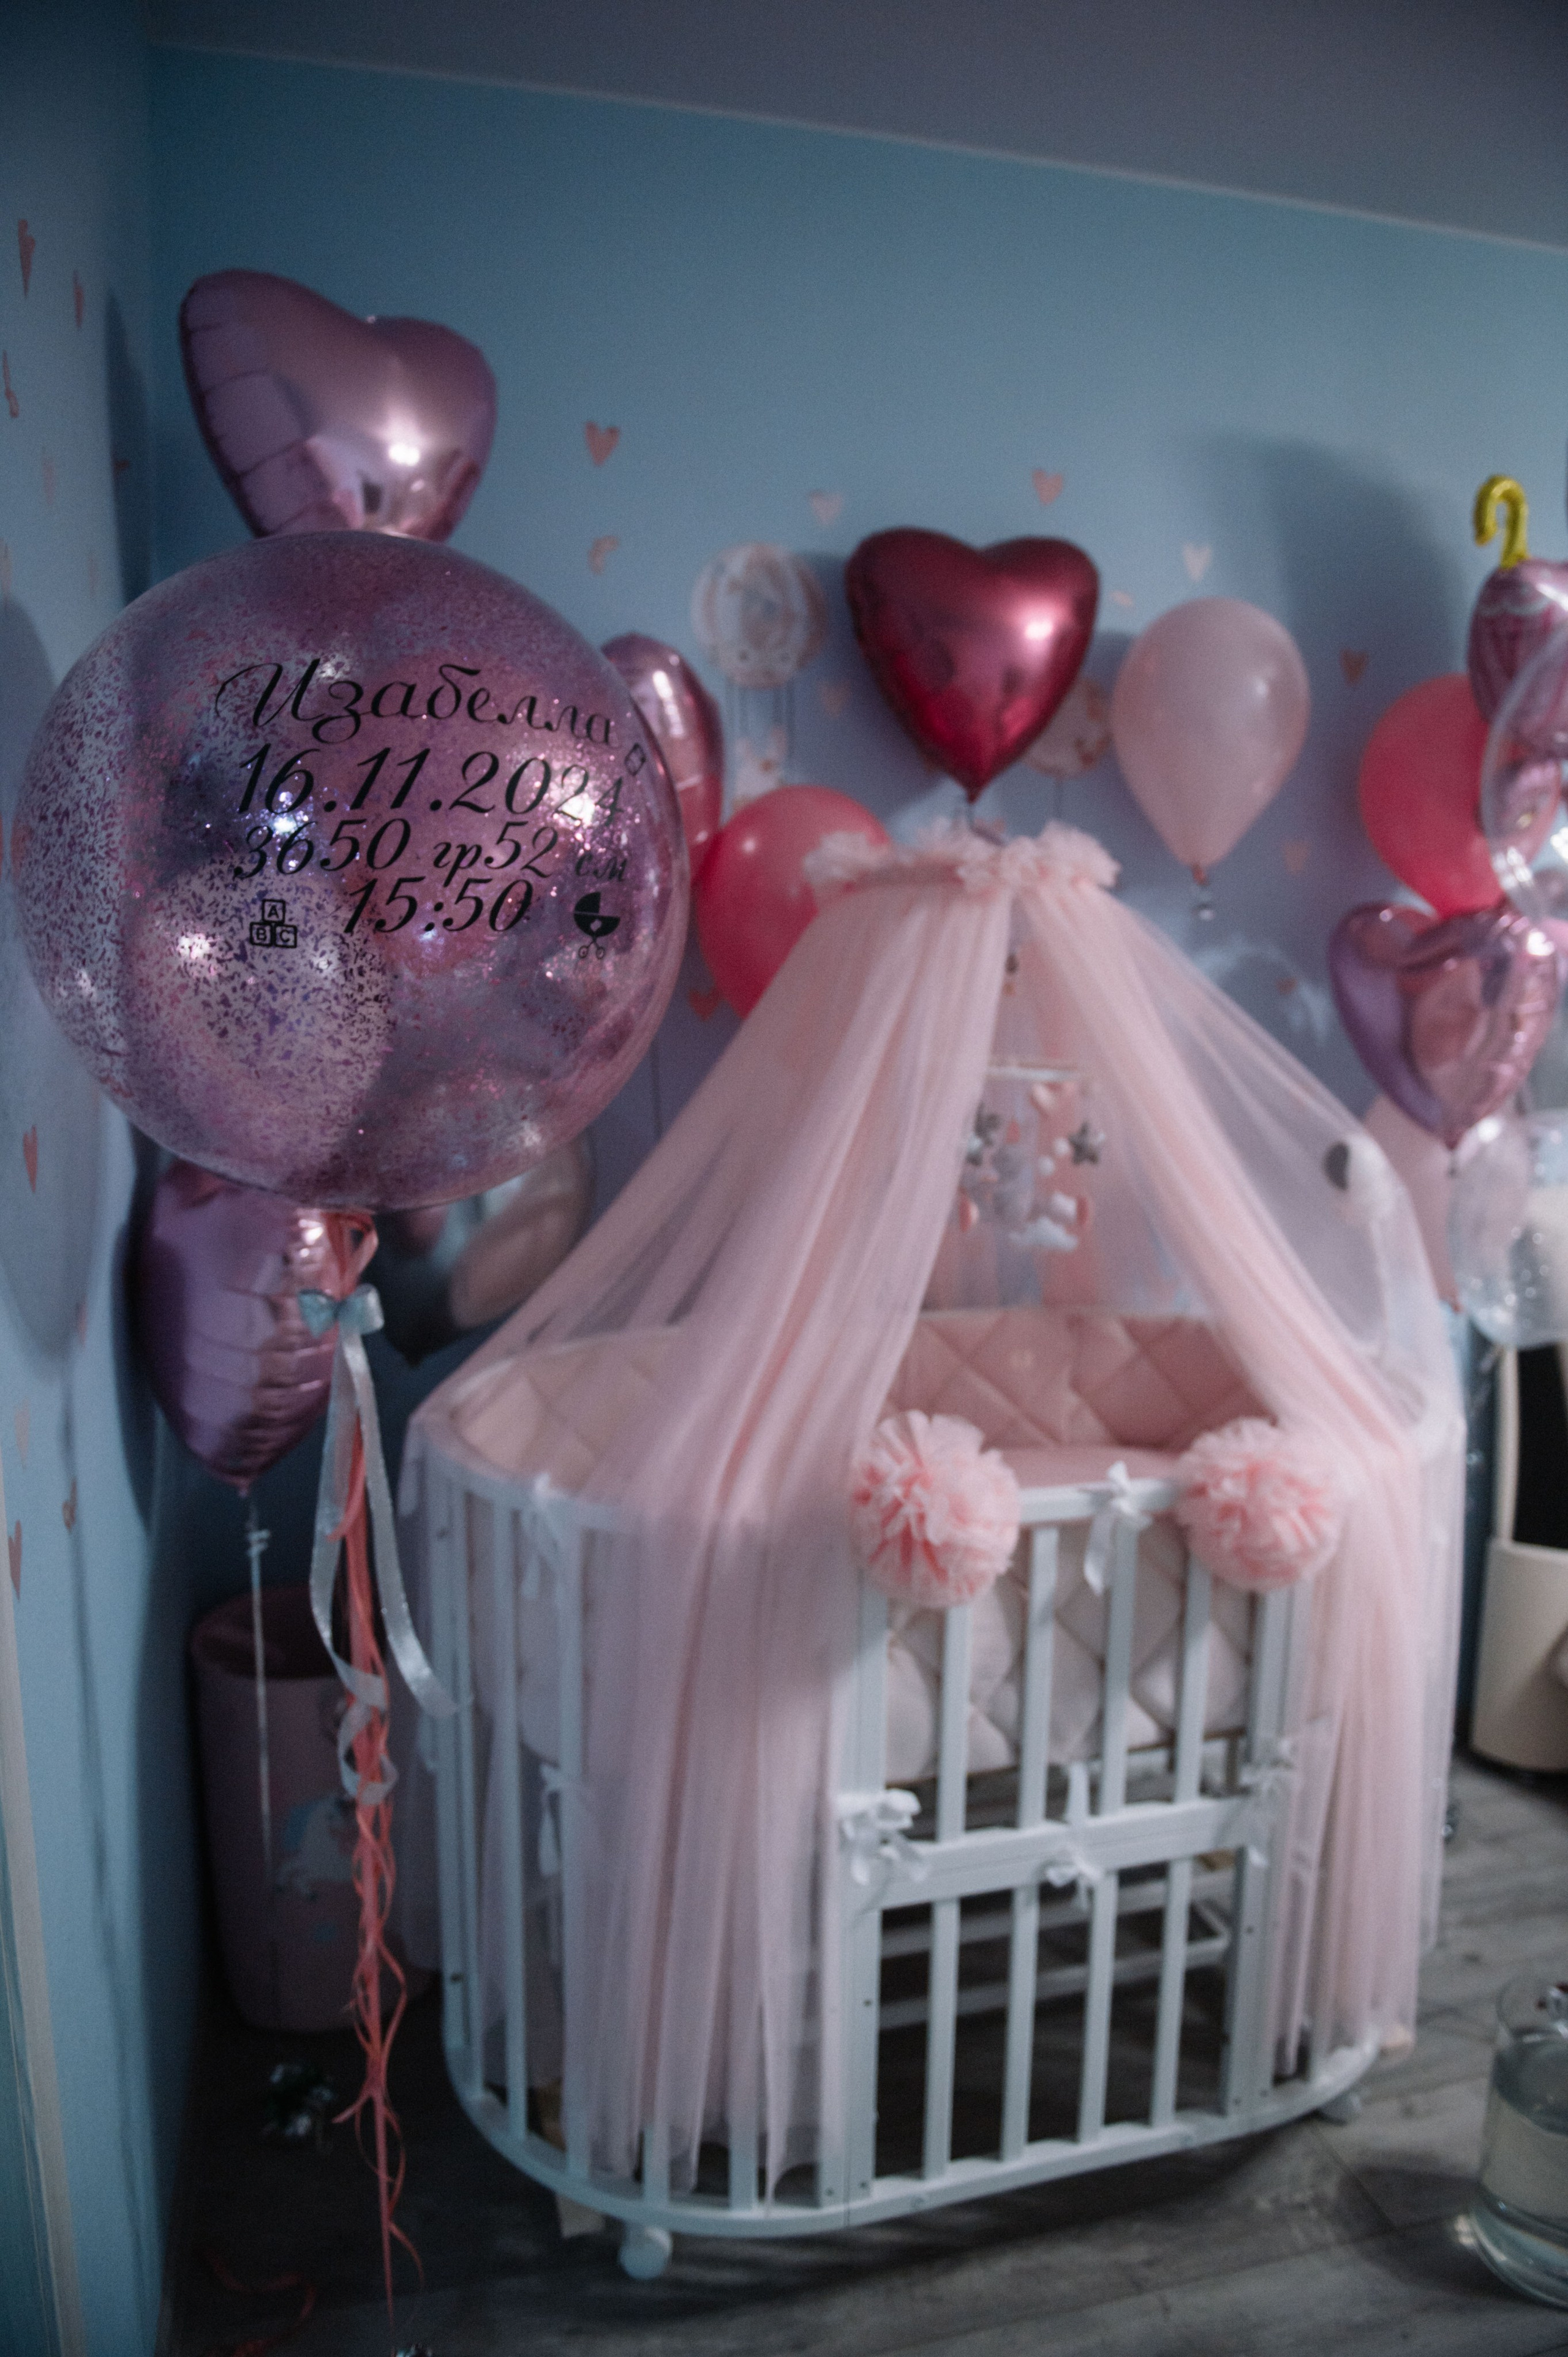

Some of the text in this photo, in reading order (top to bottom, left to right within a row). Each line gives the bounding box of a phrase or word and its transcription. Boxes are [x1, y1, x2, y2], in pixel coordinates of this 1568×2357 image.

[215, 658, 612, 744] Изабелла
[238, 743, 624, 827] 16.11.2024
[233, 817, 412, 879] 3650
[575, 853, 628, 882] см
[256, 928, 292, 943] B C
[268, 905, 279, 918] A
[344, 877, 533, 934] 15:50
